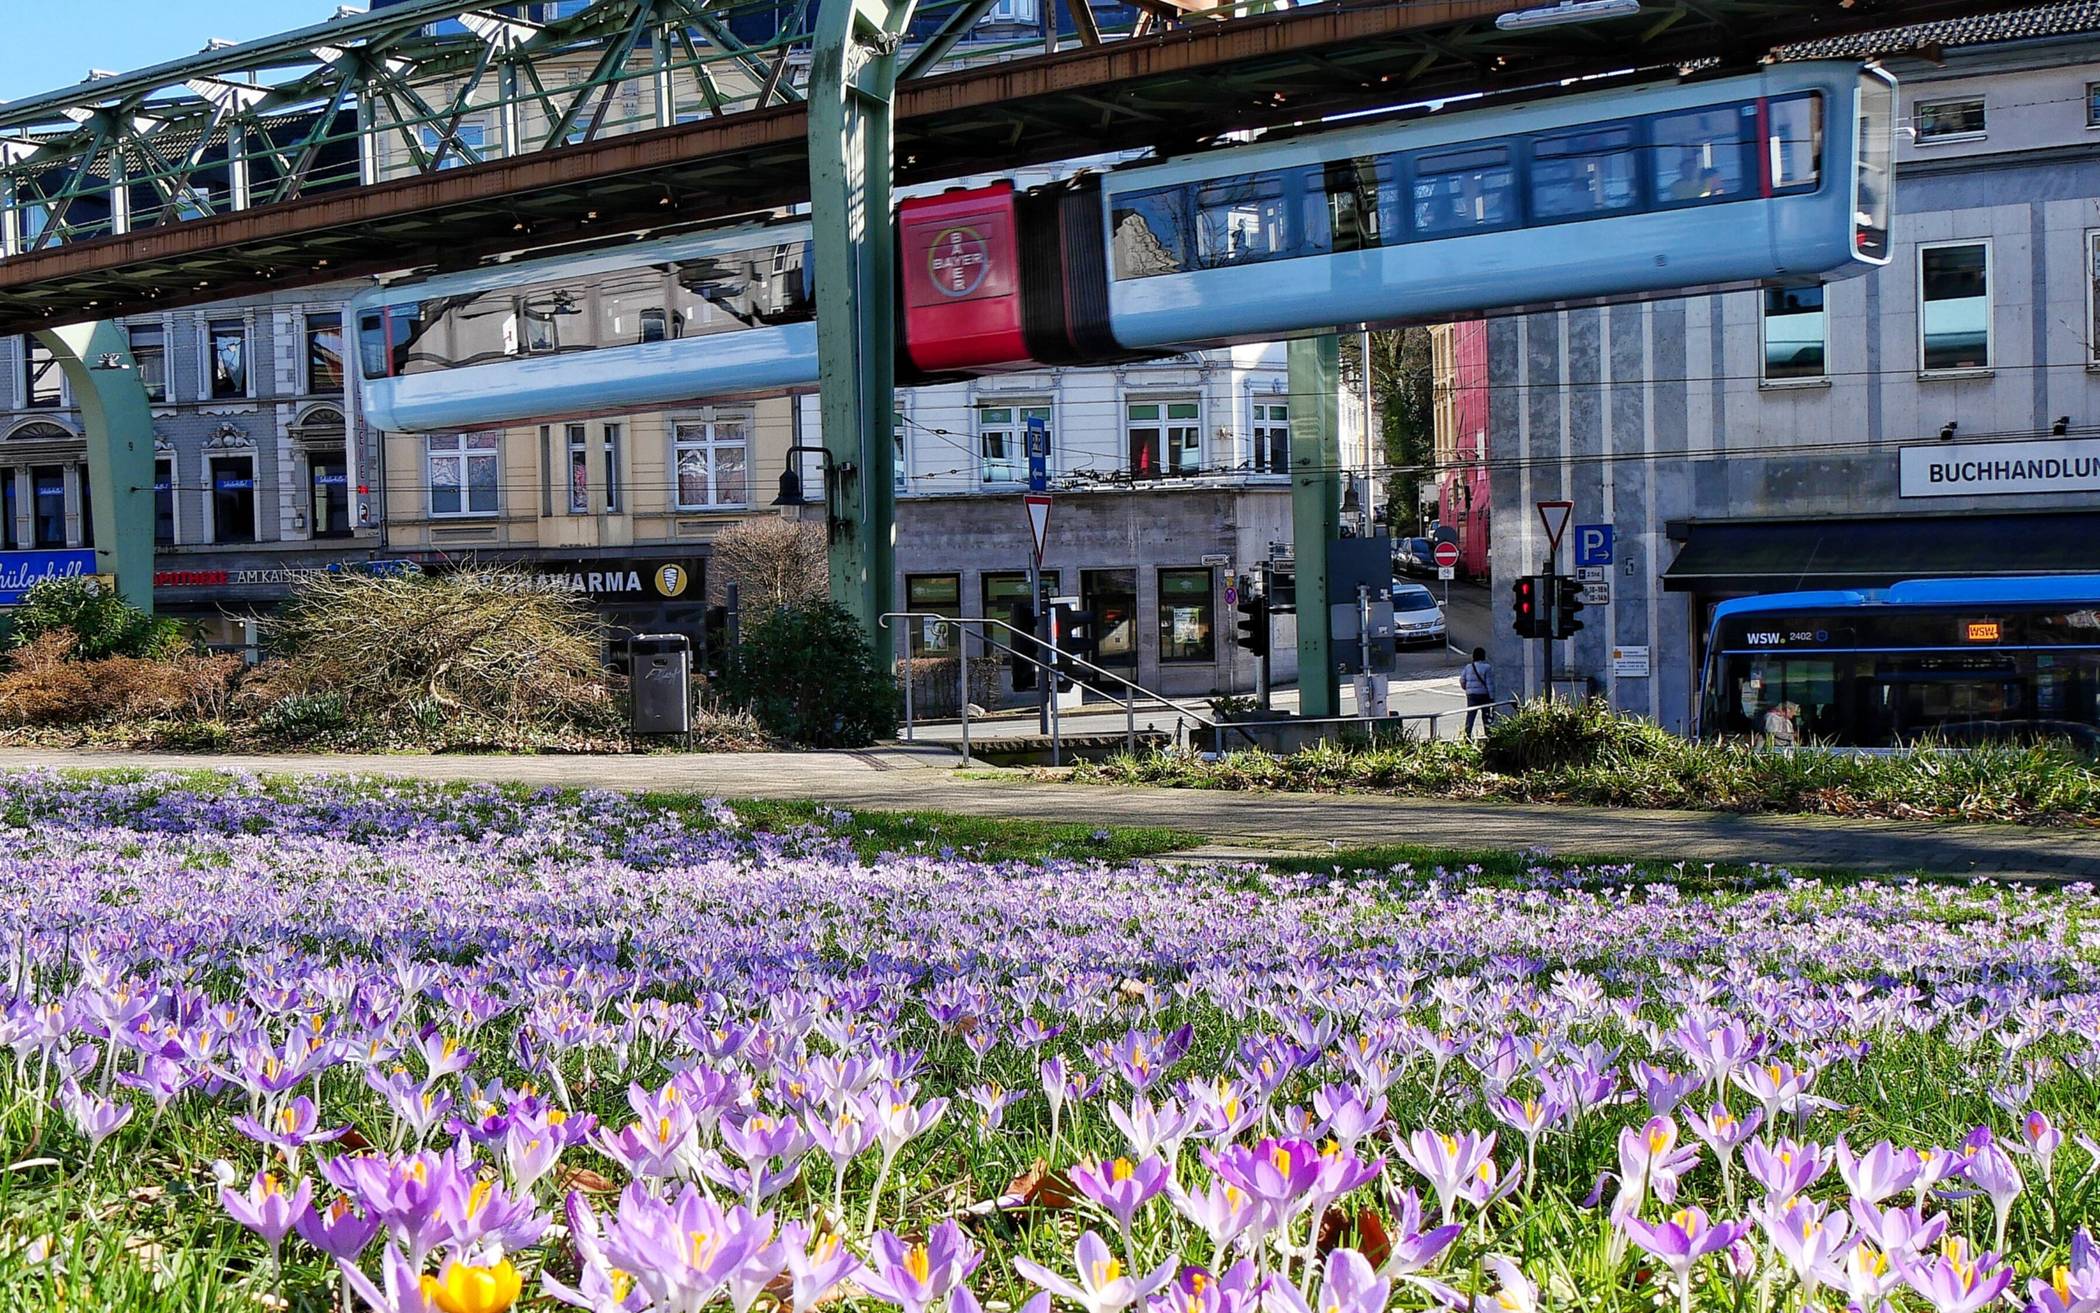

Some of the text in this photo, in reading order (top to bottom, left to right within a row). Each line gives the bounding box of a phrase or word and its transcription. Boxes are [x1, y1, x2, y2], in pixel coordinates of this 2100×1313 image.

[933, 252, 984, 271] BAYER
[950, 232, 965, 291] BAYER
[1583, 529, 1604, 561] P
[238, 571, 258, 583] AM
[1789, 631, 1812, 641] 2402
